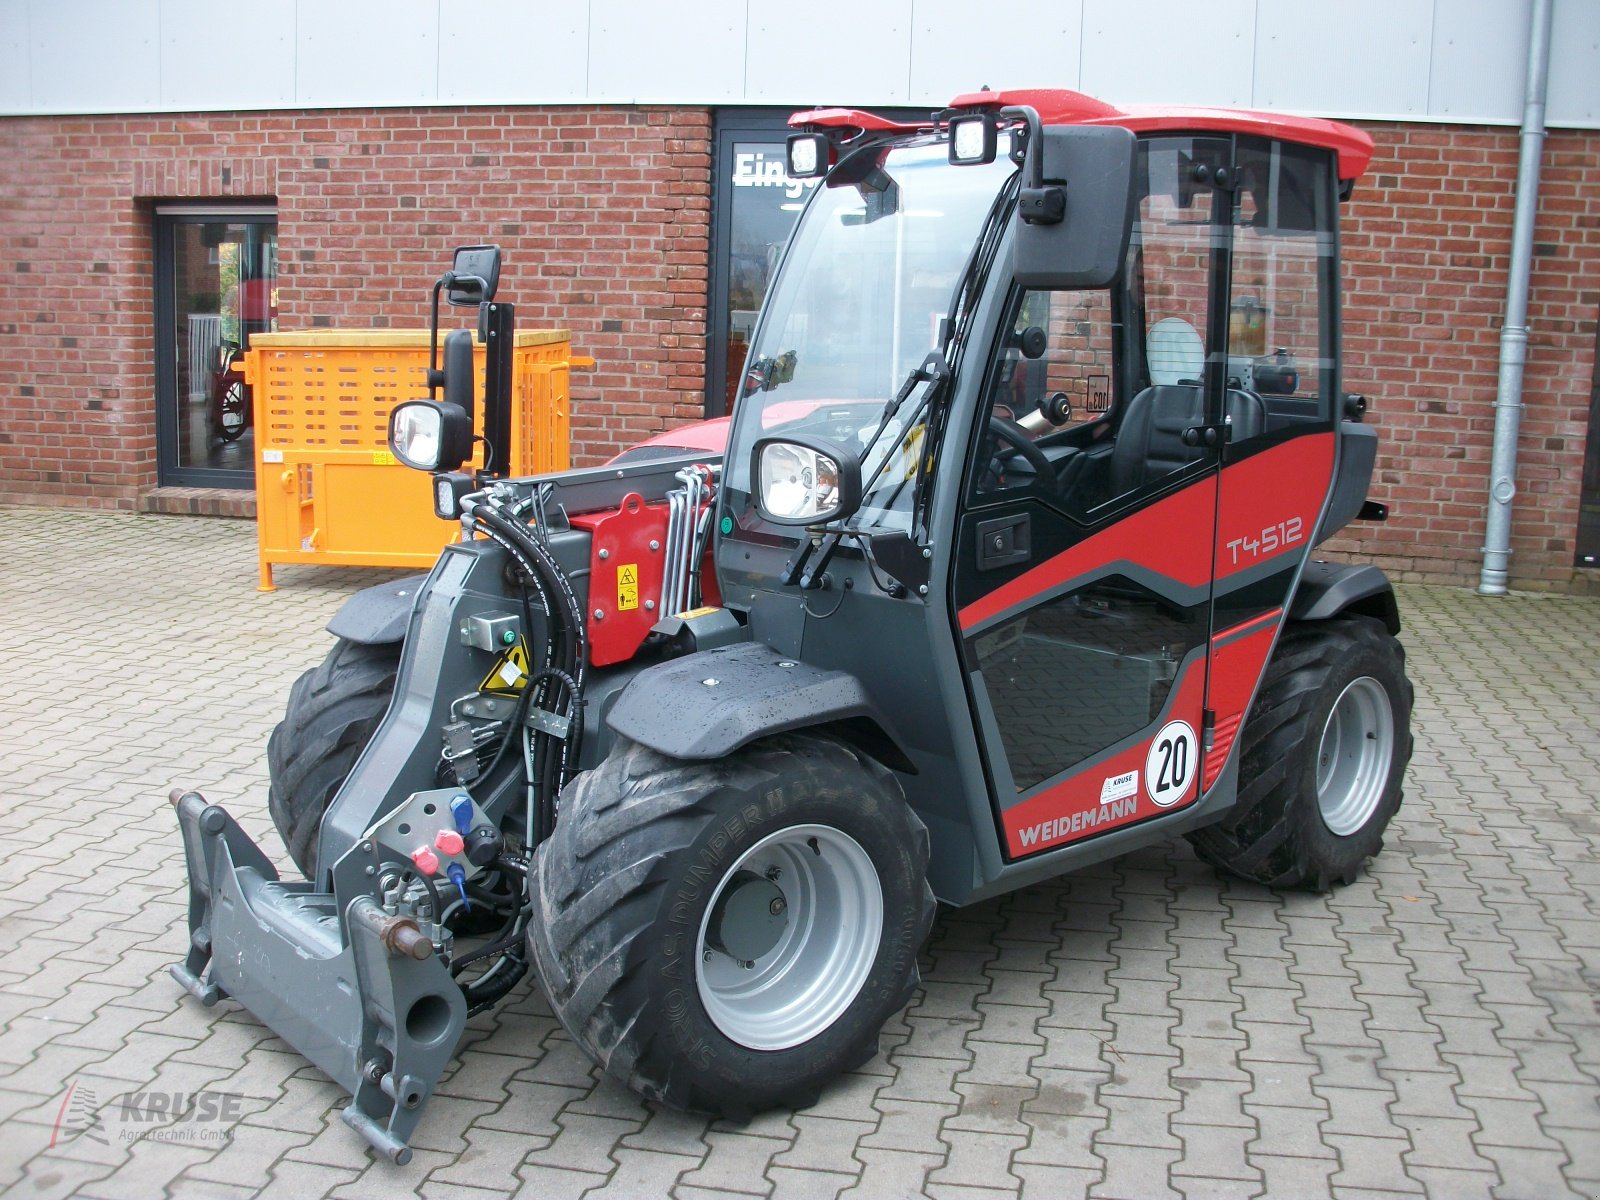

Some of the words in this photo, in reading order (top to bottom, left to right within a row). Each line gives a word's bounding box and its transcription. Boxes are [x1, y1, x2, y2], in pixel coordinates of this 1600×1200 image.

[733, 152, 836, 199] Eing
[1226, 515, 1303, 565] T4512
[1112, 774, 1133, 787] KRUSE
[1155, 734, 1188, 794] 20
[1018, 796, 1138, 848] WEIDEMANN
[670, 802, 766, 925] DUMPER
